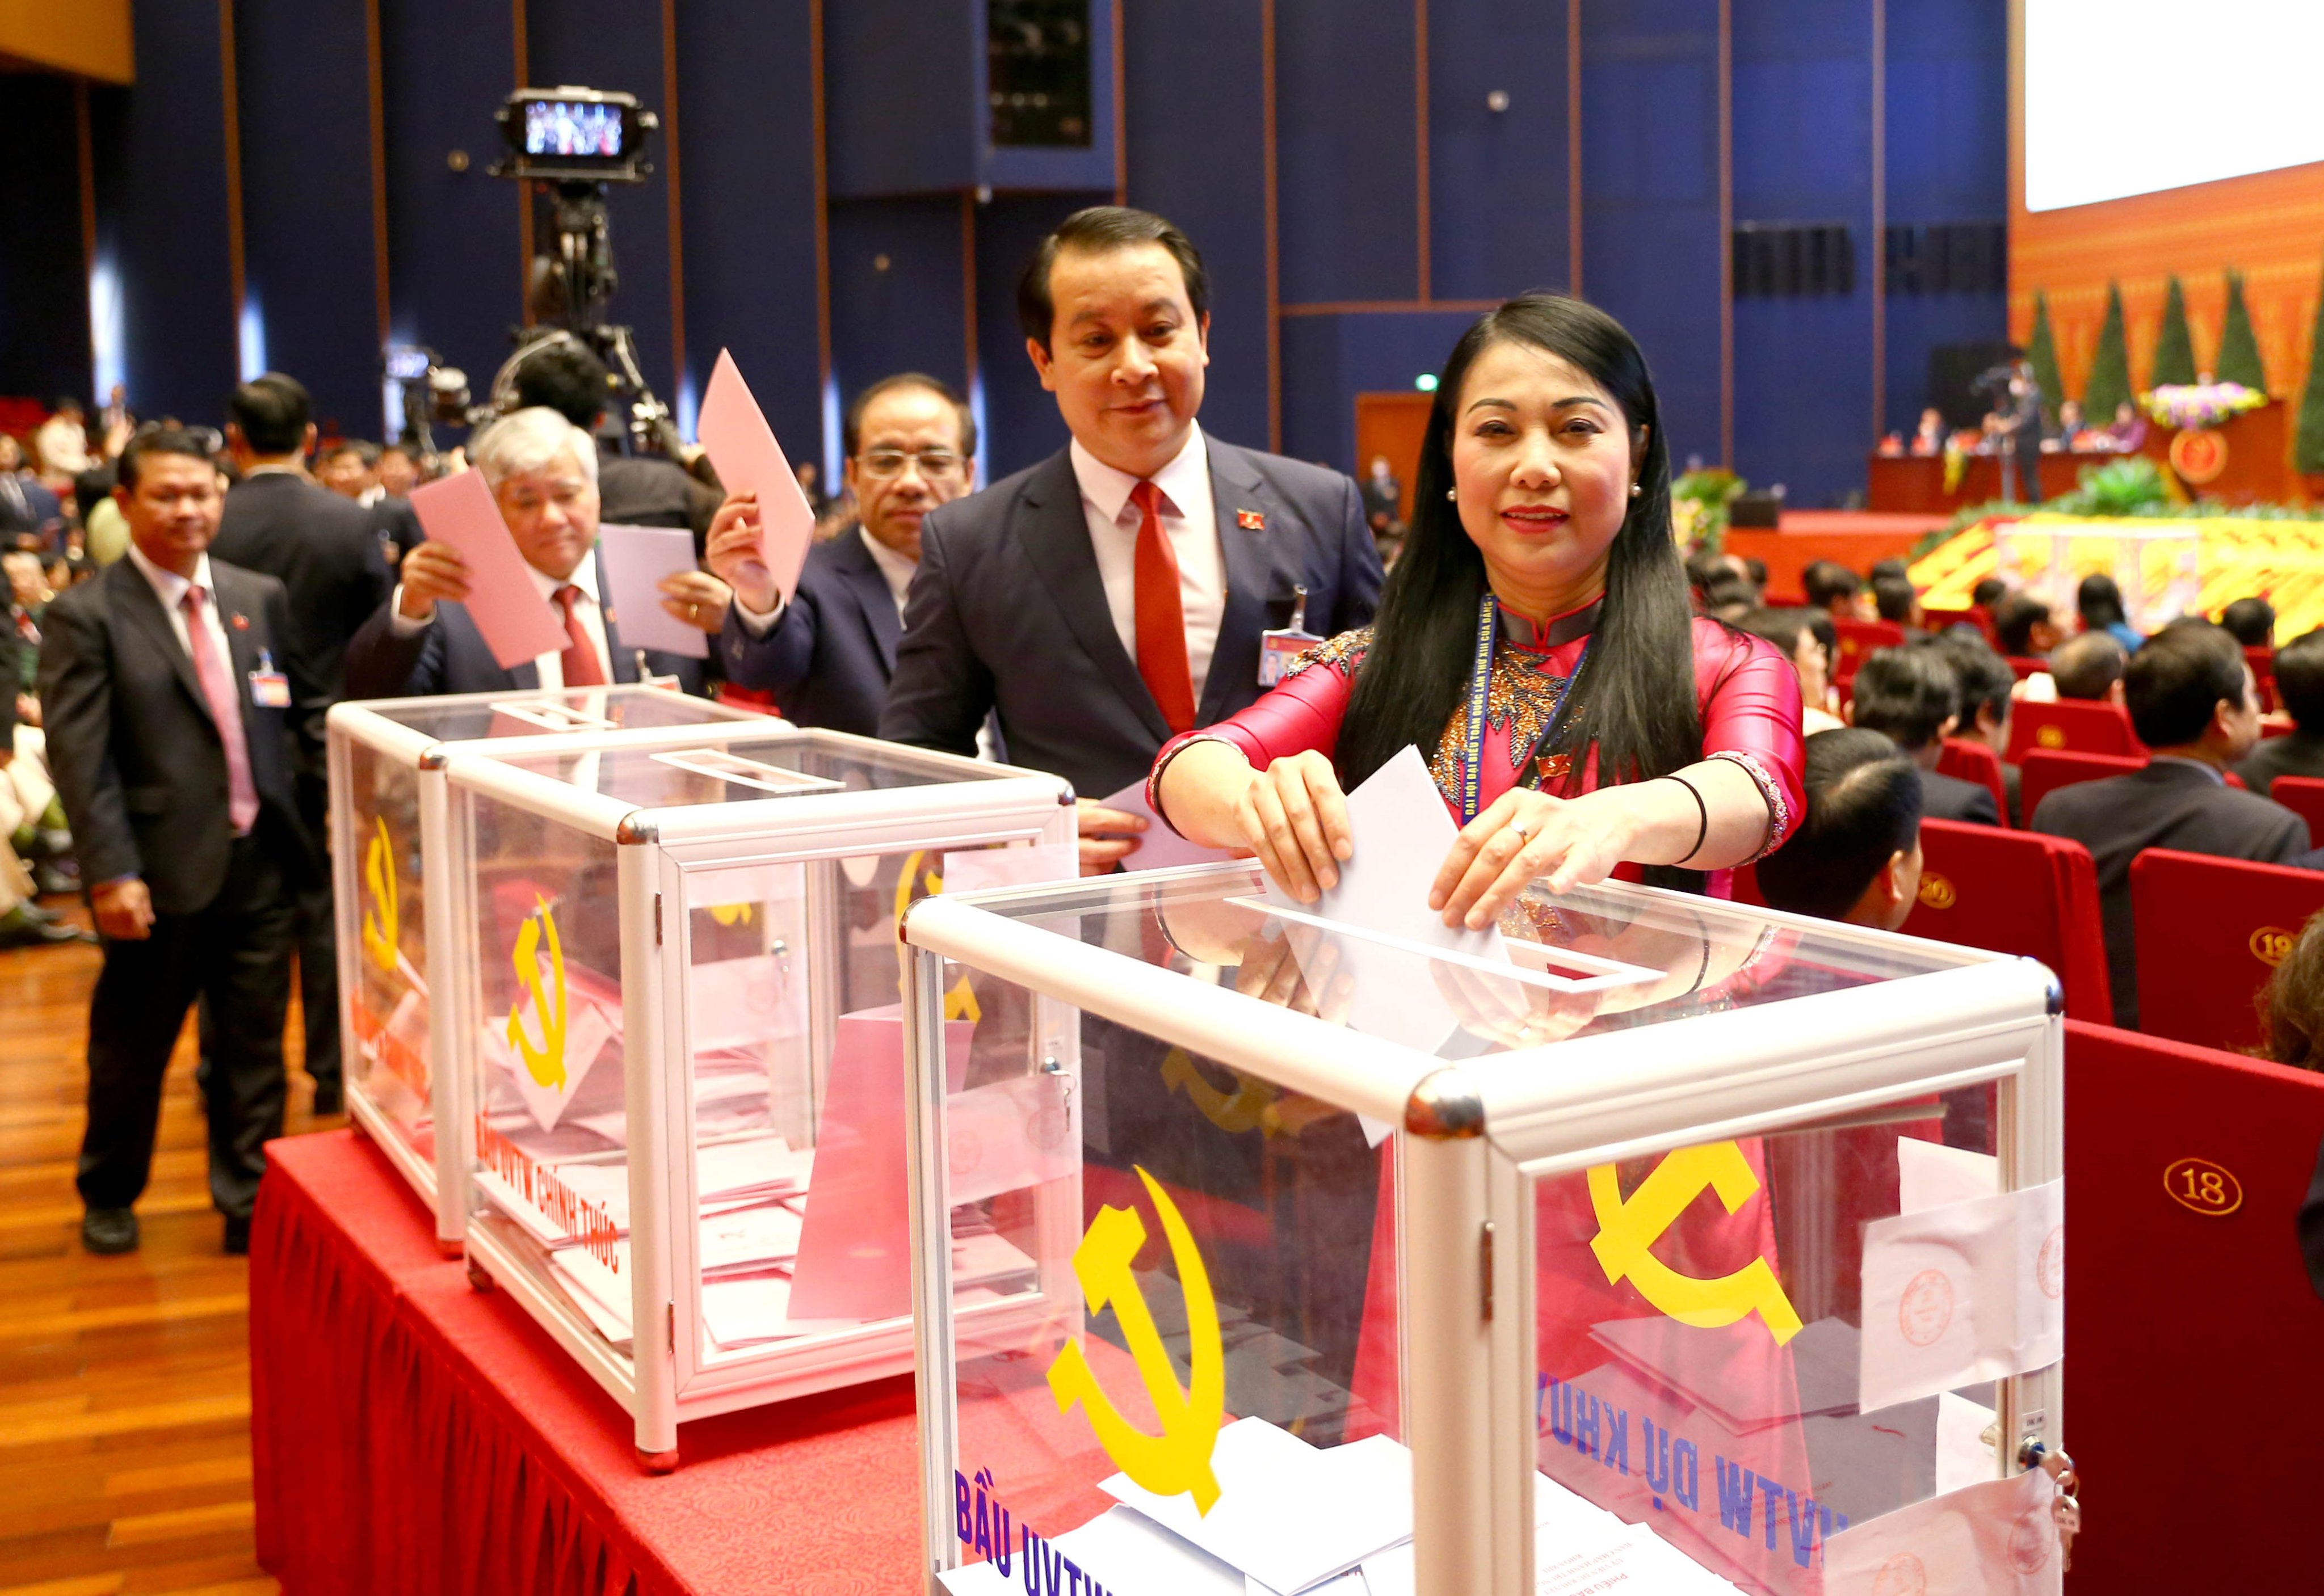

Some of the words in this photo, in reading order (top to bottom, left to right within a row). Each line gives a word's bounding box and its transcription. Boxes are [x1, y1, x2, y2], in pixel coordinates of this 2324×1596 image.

[1478, 625, 1491, 642] CỦA
[1478, 643, 1489, 658] XIII
[1472, 693, 1484, 716] QUỐC
[1469, 718, 1481, 740] TOÀN
[1464, 781, 1478, 797] HỘI
[2262, 933, 2293, 958] 19
[2182, 1168, 2225, 1205] 18
[537, 1164, 579, 1243] CHÍNH
[955, 1466, 1011, 1578] BẦU
[1022, 1523, 1113, 1596] UVT
[1594, 1572, 1629, 1590] PHIẾU
